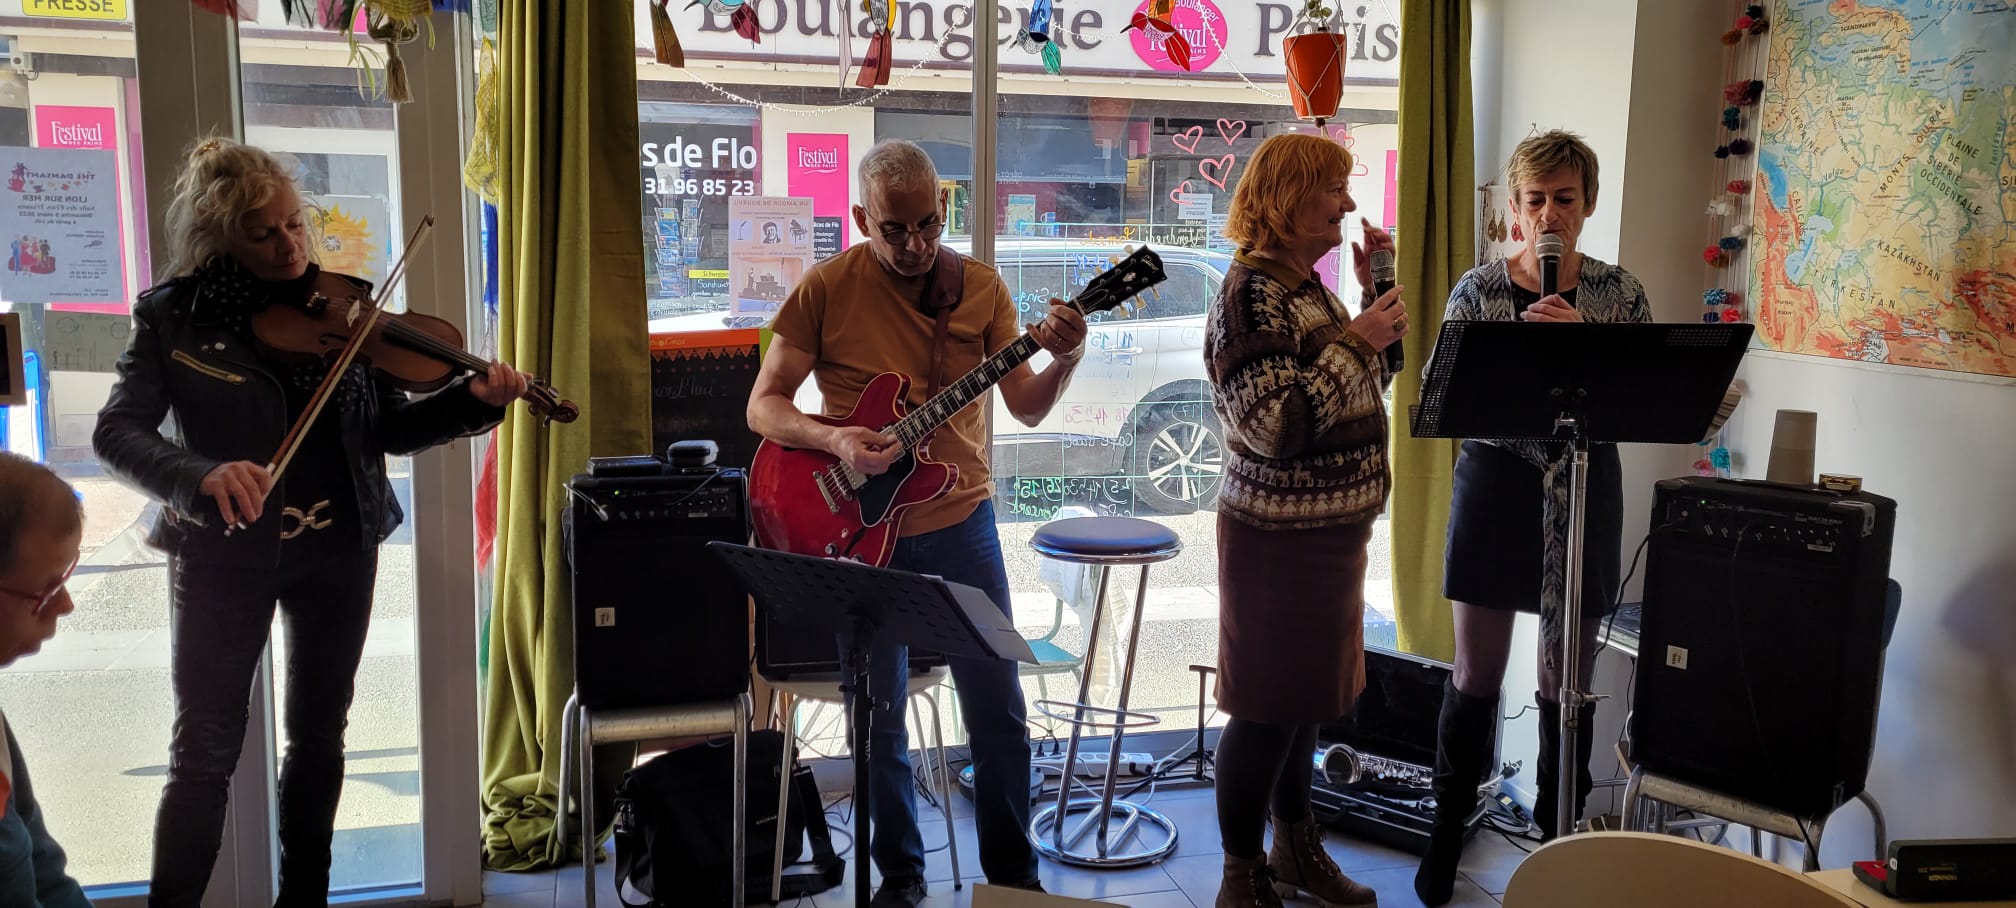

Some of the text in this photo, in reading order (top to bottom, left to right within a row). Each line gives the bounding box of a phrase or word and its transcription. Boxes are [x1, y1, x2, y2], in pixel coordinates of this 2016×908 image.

[51, 121, 103, 145] Festival
[1791, 107, 1820, 155] UKRAINE
[1947, 134, 1980, 159] PLAINE
[664, 136, 703, 168] de
[712, 138, 758, 169] Flo
[798, 146, 838, 168] Festival
[1880, 153, 1910, 193] MONTS
[1916, 103, 1947, 144] OURAL
[1948, 152, 1960, 166] DE
[645, 178, 754, 196] 31 96 85 23
[1920, 169, 1983, 216] OCCIDENTALE
[1878, 240, 1941, 281] KAZAKHSTAN
[1812, 269, 1896, 309] TURKESTAN
